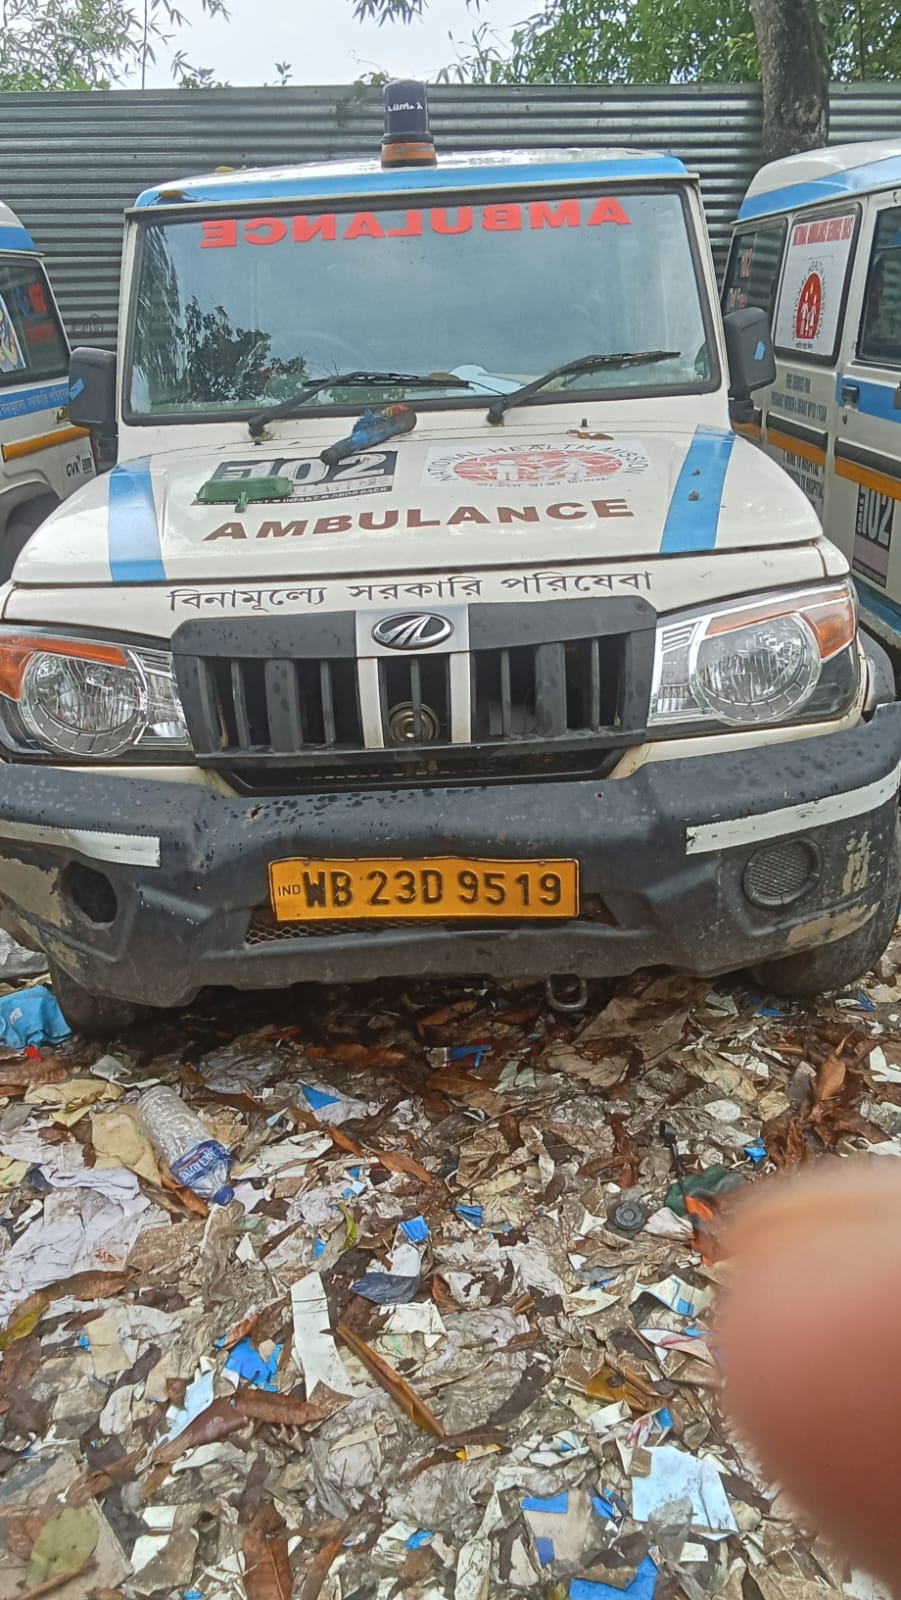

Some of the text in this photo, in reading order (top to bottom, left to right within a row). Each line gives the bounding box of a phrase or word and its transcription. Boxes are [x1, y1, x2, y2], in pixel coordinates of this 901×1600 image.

[66, 461, 80, 477] GVK
[428, 450, 487, 482] NATIONAL
[488, 443, 597, 453] HEALTH
[203, 498, 634, 541] AMBULANCE
[860, 484, 893, 546] 102
[166, 587, 328, 613] বিনামূল্যে
[346, 576, 483, 600] সরকারি
[277, 869, 562, 908] IND WB 23D 9519
